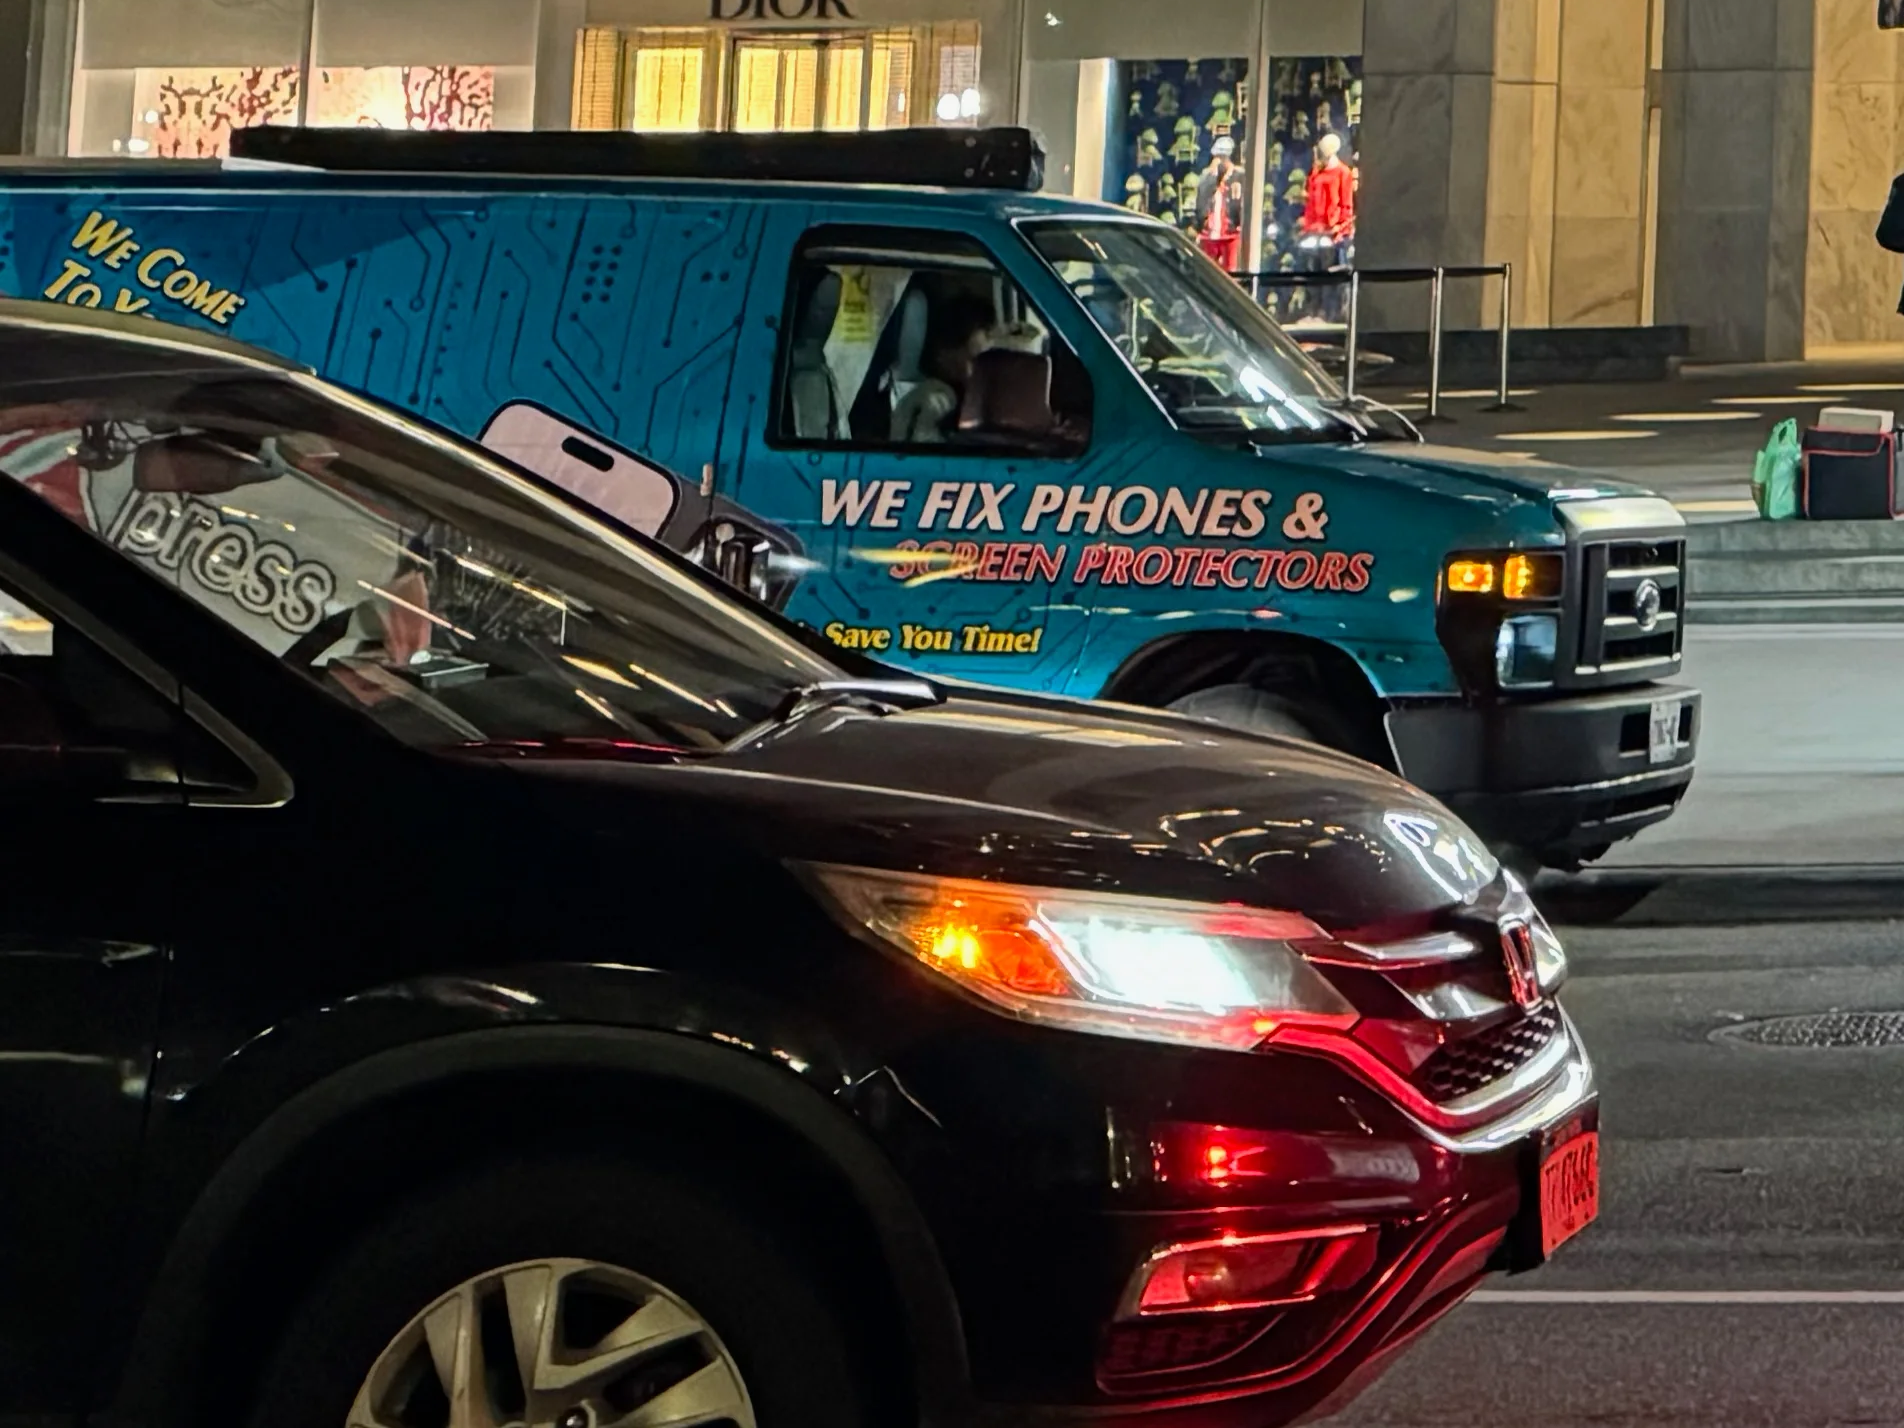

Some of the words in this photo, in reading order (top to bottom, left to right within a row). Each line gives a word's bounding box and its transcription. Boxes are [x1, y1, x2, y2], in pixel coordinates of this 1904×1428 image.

[821, 479, 911, 527] WE
[918, 480, 1016, 530] FIX
[1022, 484, 1272, 539] PHONES
[1282, 491, 1329, 540] &
[889, 539, 1067, 583] SCREEN
[1073, 542, 1375, 592] PROTECTORS
[826, 622, 890, 649] Save
[902, 624, 953, 651] You
[962, 624, 1043, 653] Time!
